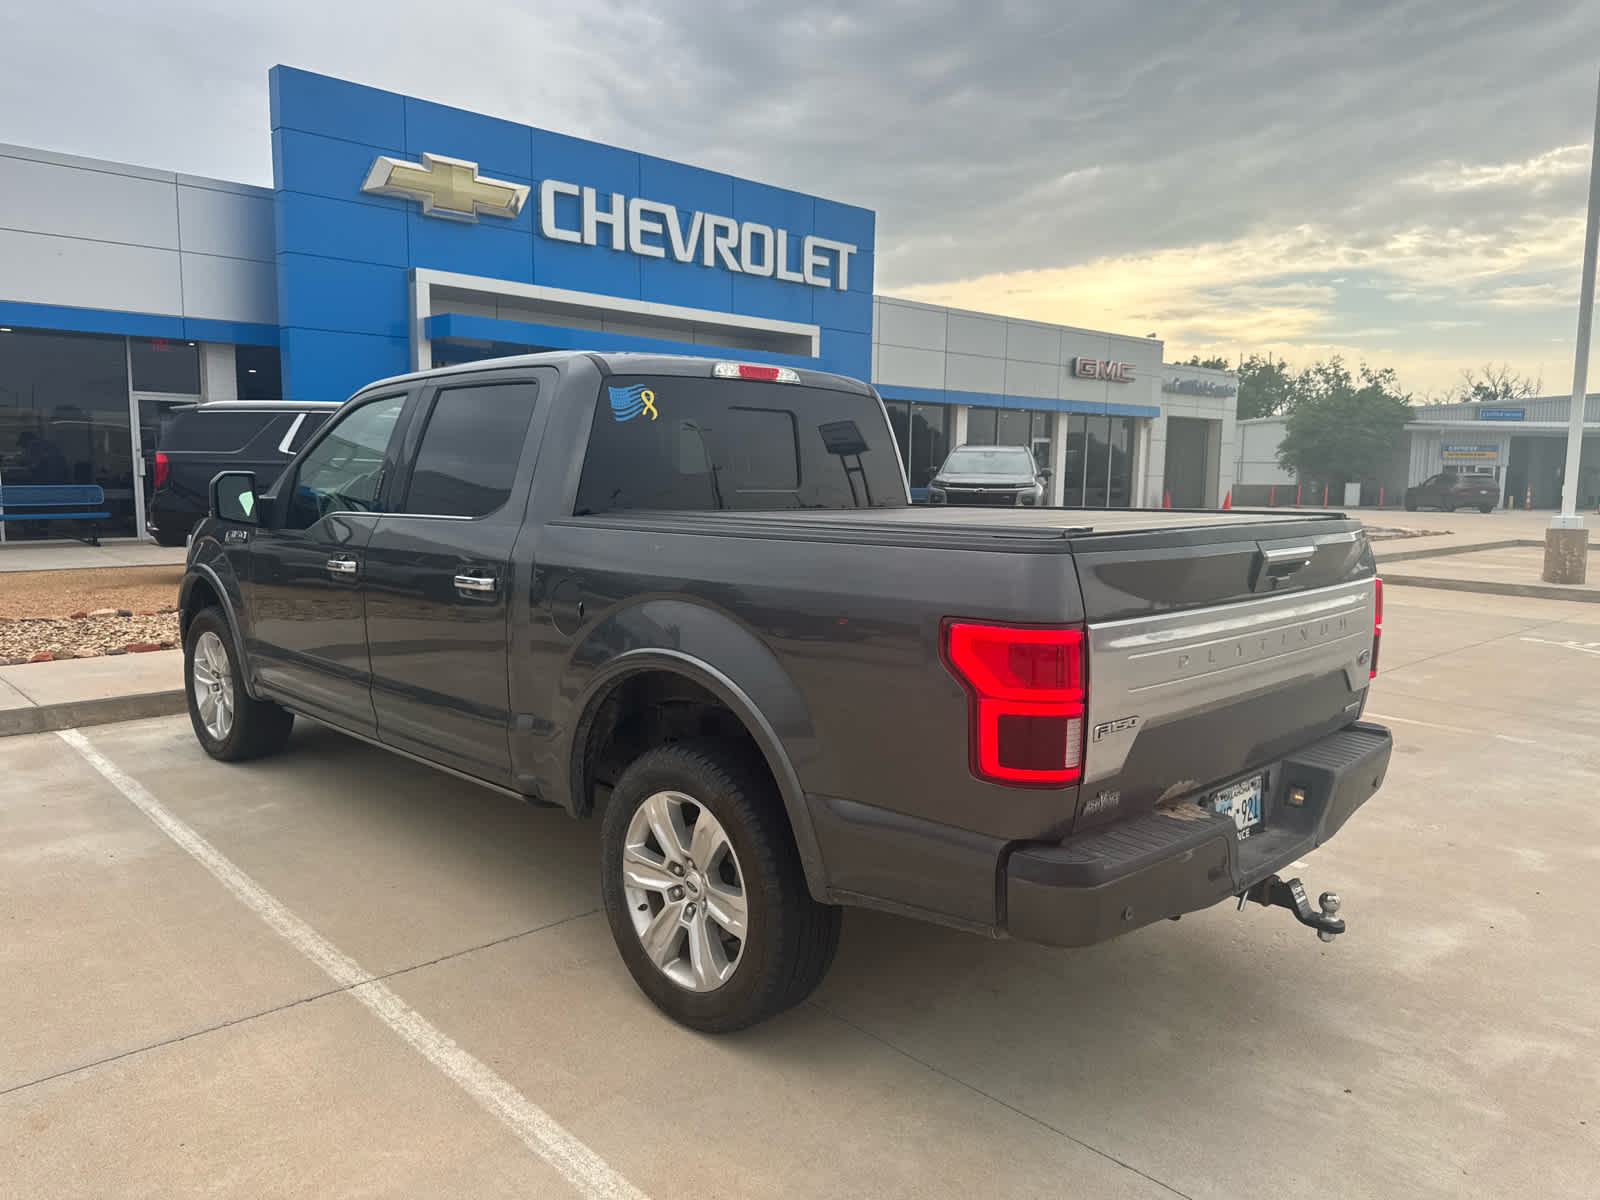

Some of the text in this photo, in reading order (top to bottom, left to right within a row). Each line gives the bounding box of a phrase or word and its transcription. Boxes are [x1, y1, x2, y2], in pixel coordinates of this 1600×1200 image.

[540, 179, 857, 290] CHEVROLET
[1073, 356, 1136, 383] GMC
[1178, 617, 1347, 669] PLATINUM
